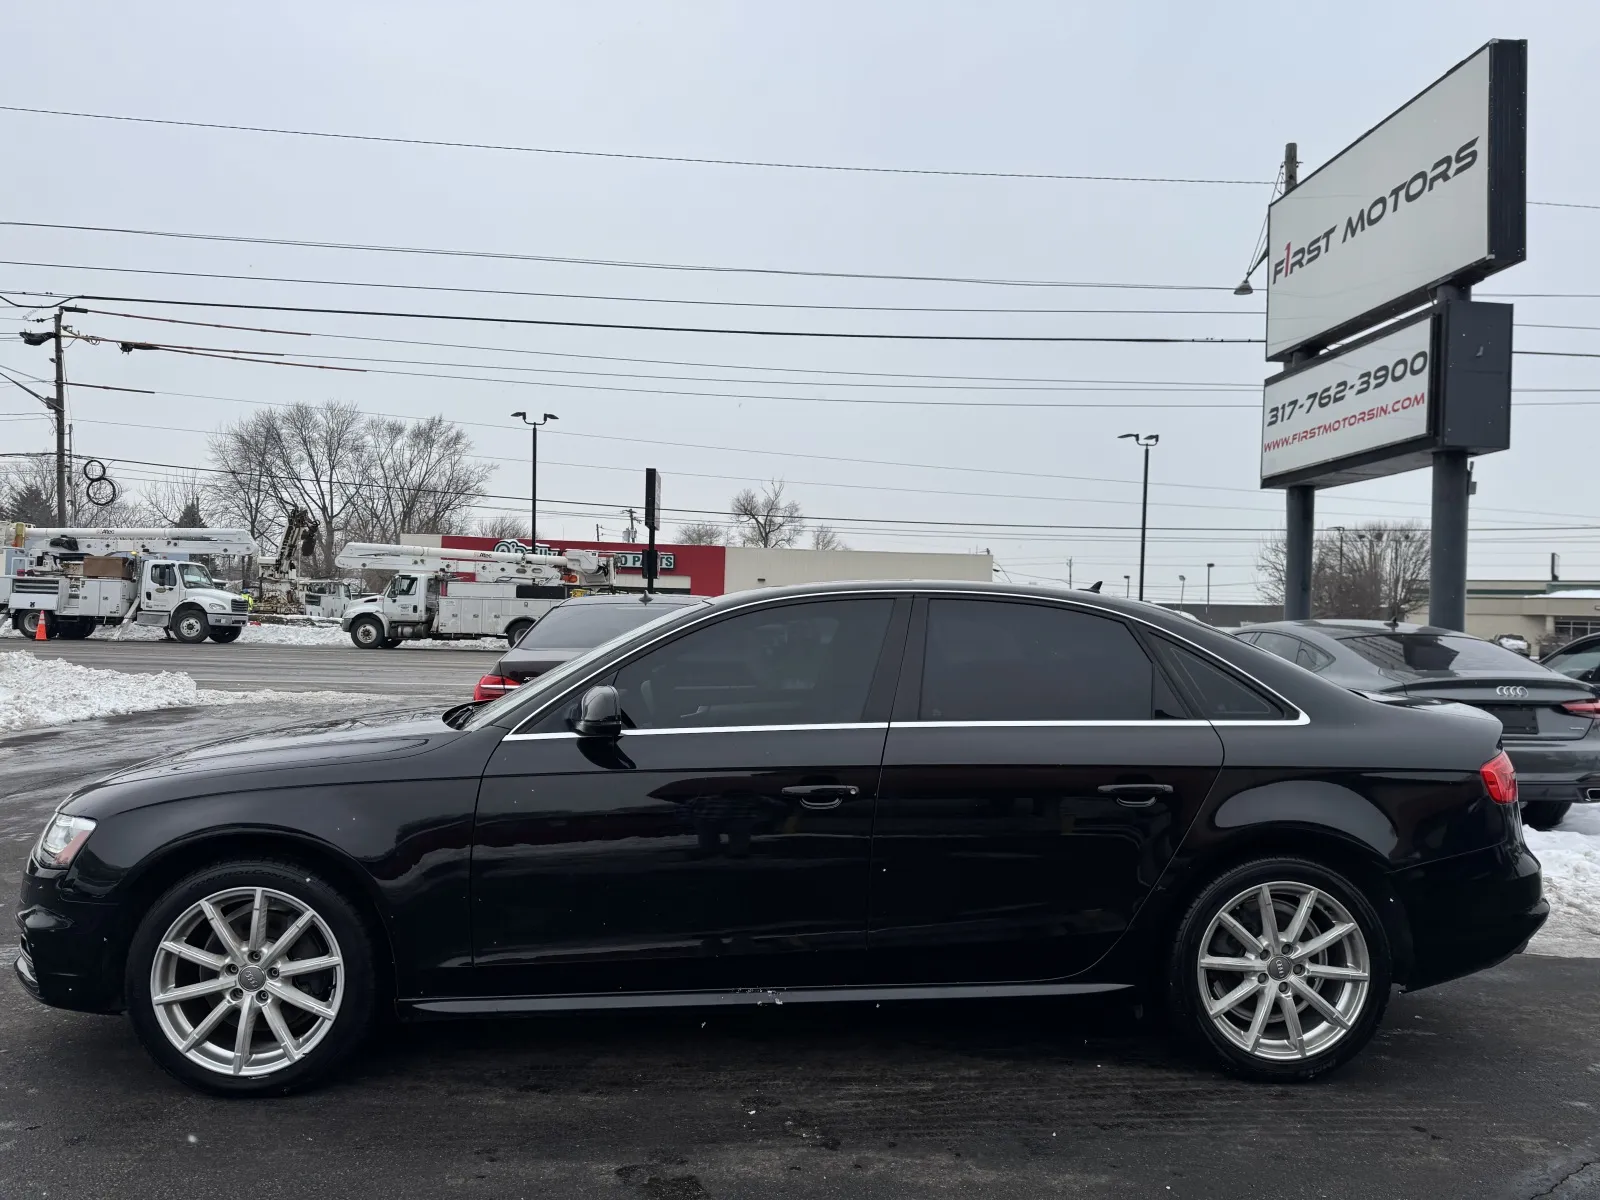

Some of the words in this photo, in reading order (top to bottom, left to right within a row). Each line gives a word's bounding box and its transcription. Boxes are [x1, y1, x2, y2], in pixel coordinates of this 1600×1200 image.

[1342, 135, 1480, 244] MOTORS
[1264, 392, 1425, 452] WWW.FIRSTMOTORSIN.COM
[1267, 351, 1428, 427] 317-762-3900
[632, 555, 673, 567] PTS
